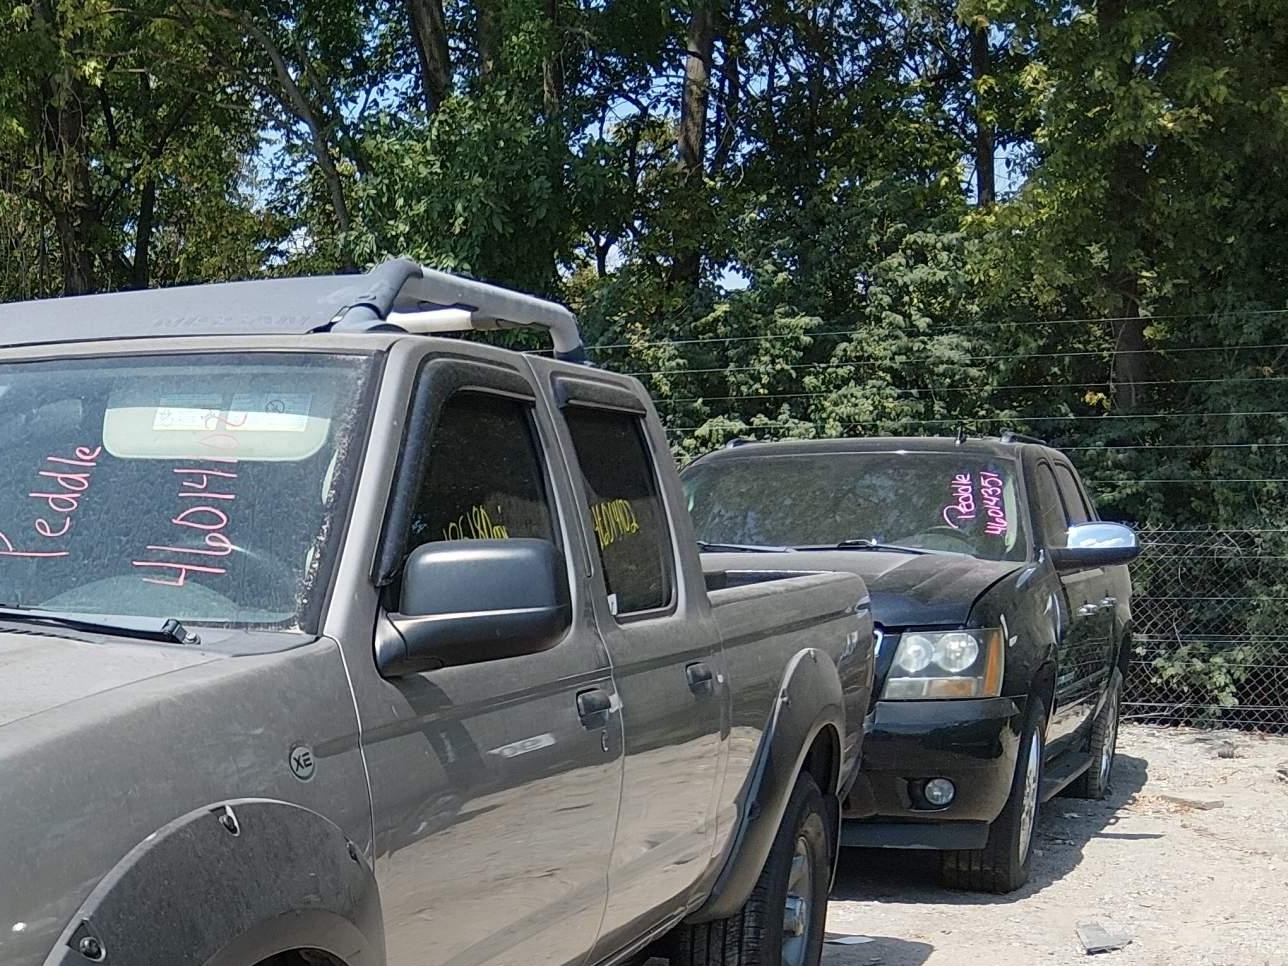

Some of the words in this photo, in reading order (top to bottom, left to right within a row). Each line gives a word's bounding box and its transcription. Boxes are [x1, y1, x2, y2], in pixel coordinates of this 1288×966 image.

[943, 472, 976, 529] Peddle
[980, 471, 1007, 534] 46014351
[292, 751, 313, 772] XE
